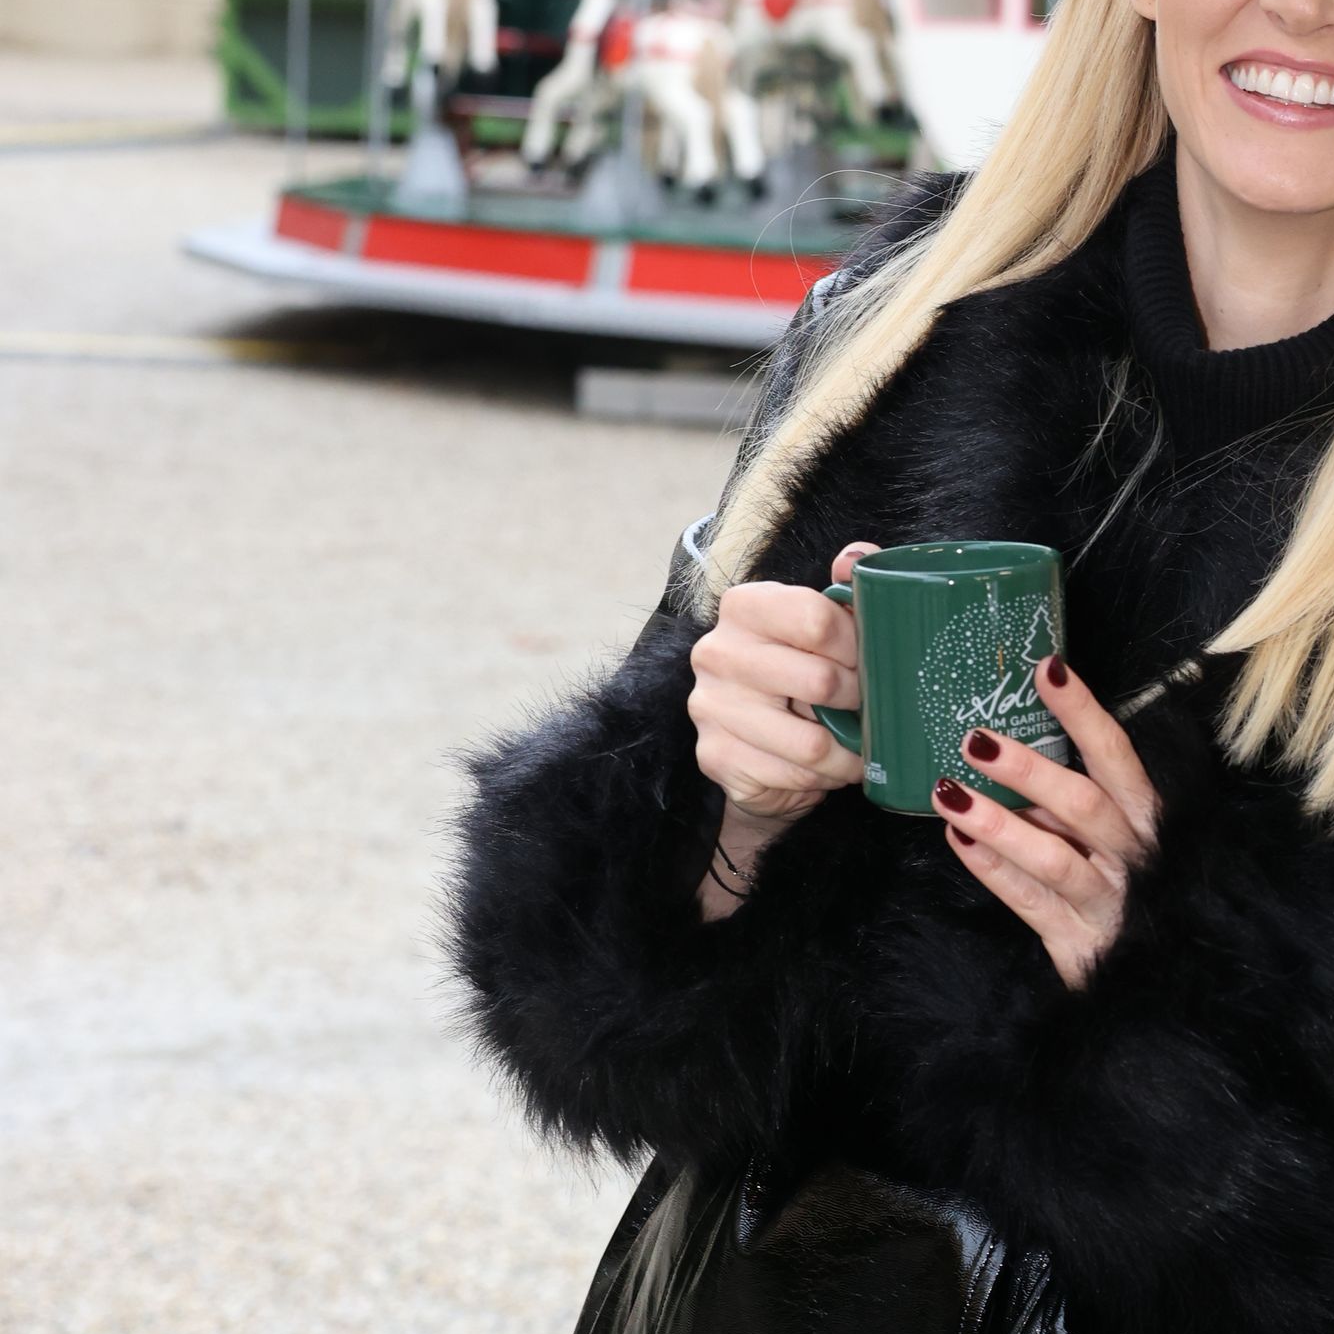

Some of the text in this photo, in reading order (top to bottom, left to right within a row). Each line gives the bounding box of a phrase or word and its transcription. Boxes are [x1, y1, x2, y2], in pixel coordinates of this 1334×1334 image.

[956, 667, 1038, 721] Adv
[989, 710, 1052, 729] IM GARTE
